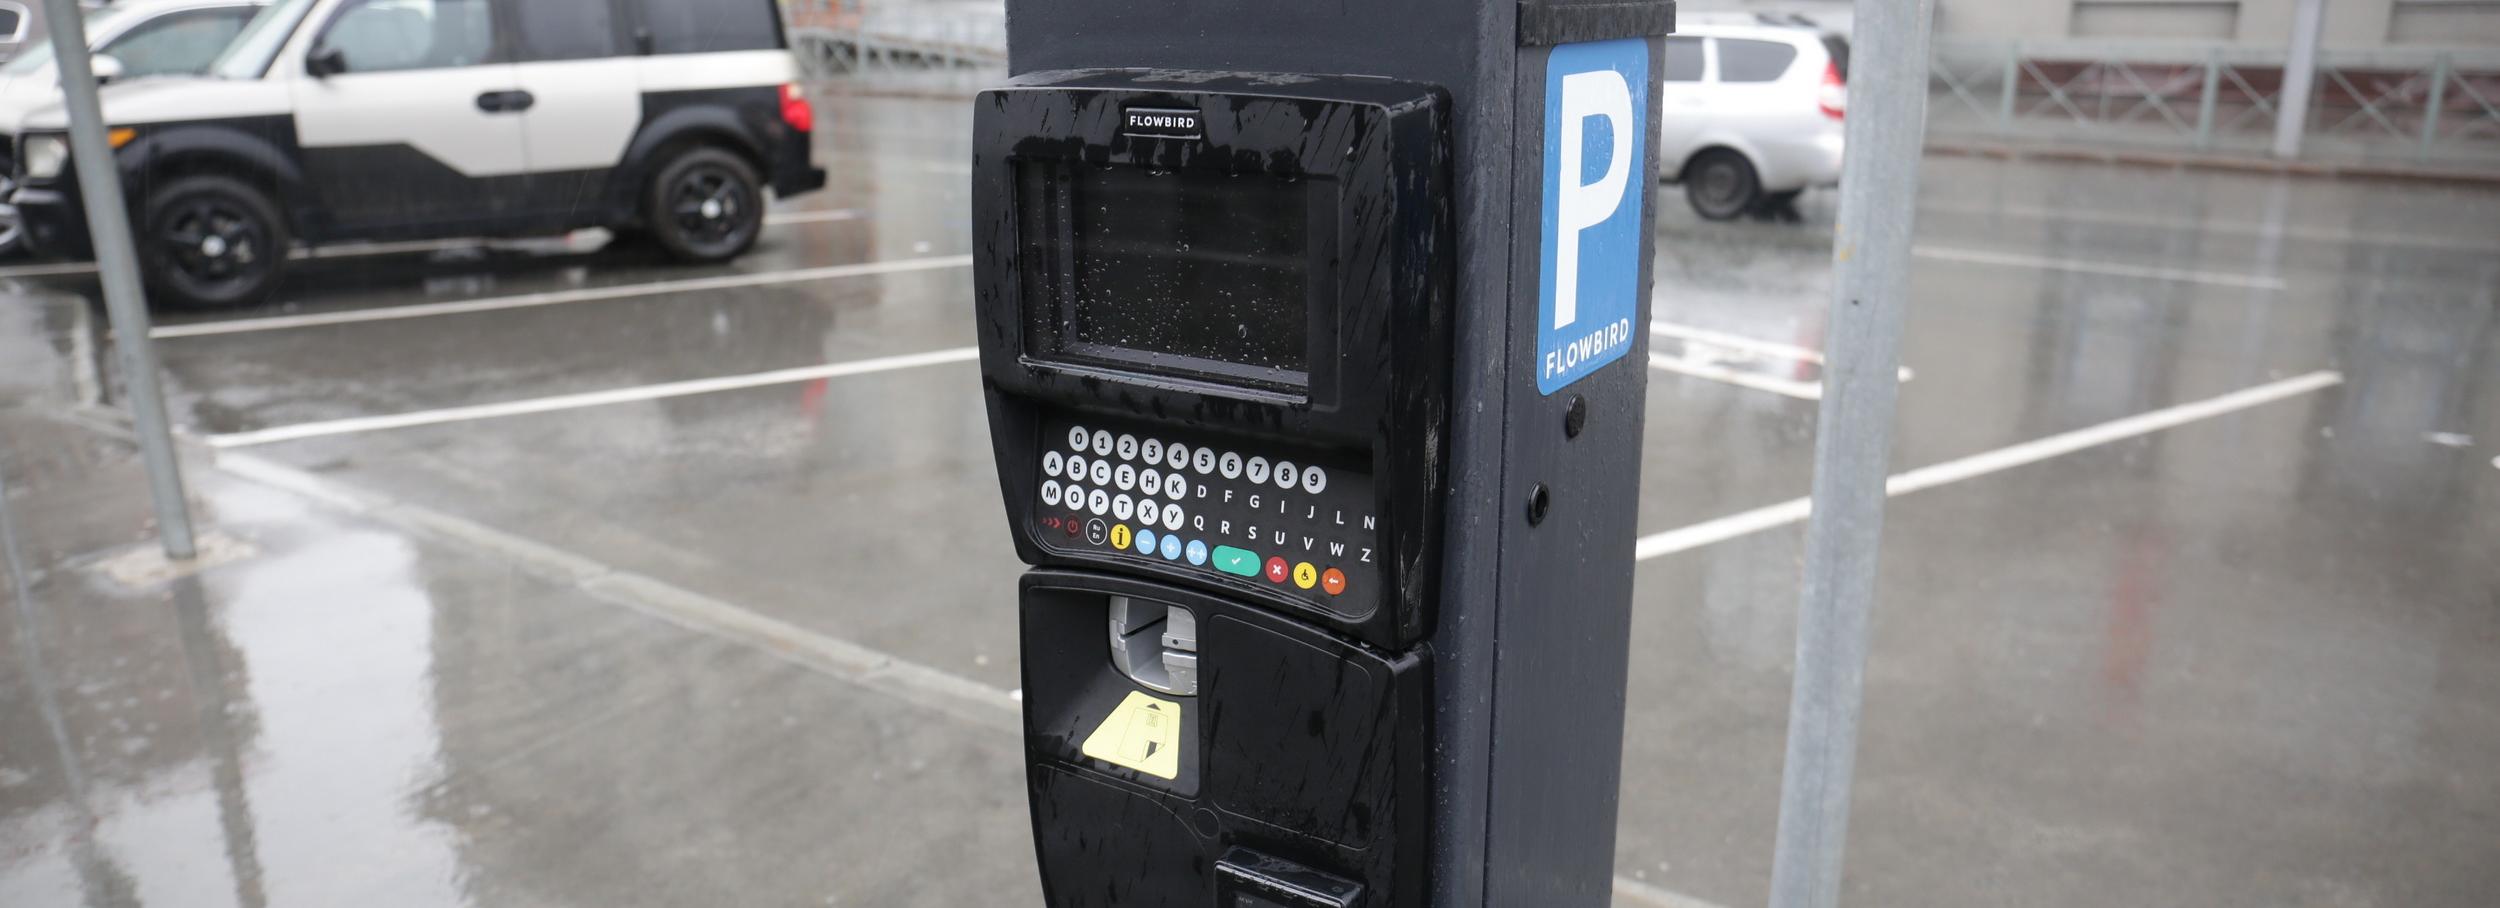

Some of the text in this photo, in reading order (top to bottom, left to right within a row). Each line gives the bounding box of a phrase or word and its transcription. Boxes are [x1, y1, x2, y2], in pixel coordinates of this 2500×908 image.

[1130, 115, 1194, 128] FLOWBIRD
[1554, 70, 1633, 330] P
[1546, 318, 1629, 380] FLOWBIRD
[1074, 431, 1319, 487] 0 1 2 3 4 5 6 7 8 9
[1045, 485, 1057, 500] M
[1070, 490, 1080, 504] O
[1095, 495, 1104, 508] P
[1118, 500, 1128, 514] T
[1143, 504, 1153, 519] X
[1193, 514, 1204, 532] Q
[1220, 520, 1230, 535] R
[1247, 525, 1257, 540] S
[1274, 530, 1286, 545] U
[1303, 536, 1314, 551] V
[1329, 541, 1345, 557] W
[1360, 547, 1372, 563] Z
[1048, 457, 1376, 531] A B C E H K D F G I J L N
